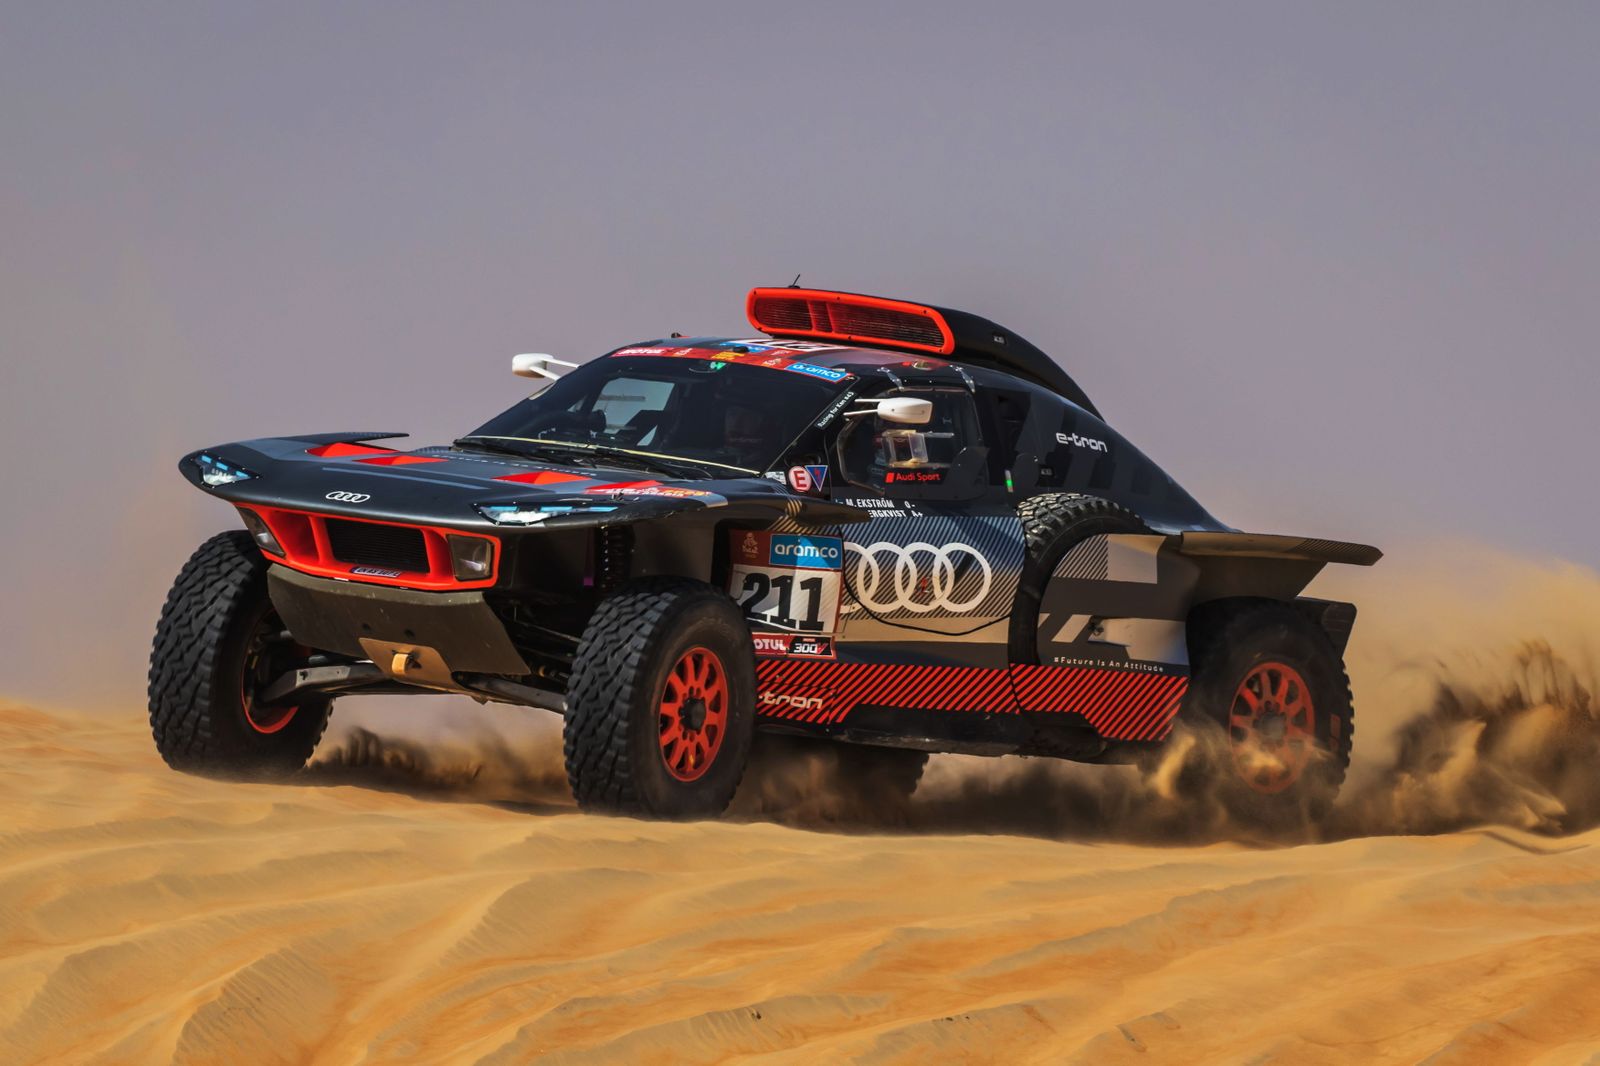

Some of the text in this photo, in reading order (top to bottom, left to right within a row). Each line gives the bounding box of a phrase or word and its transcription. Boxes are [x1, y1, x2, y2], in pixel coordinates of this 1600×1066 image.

[792, 363, 841, 379] aramco
[1056, 432, 1108, 453] e-tron
[793, 470, 807, 488] E
[896, 472, 941, 483] Audi Sport
[868, 509, 906, 518] ERGKVIST
[774, 543, 839, 558] aramco
[741, 572, 824, 631] 211
[753, 638, 787, 651] OTUL
[1054, 656, 1094, 666] #Future
[1124, 661, 1164, 673] Attitude
[758, 691, 823, 709] -tron
